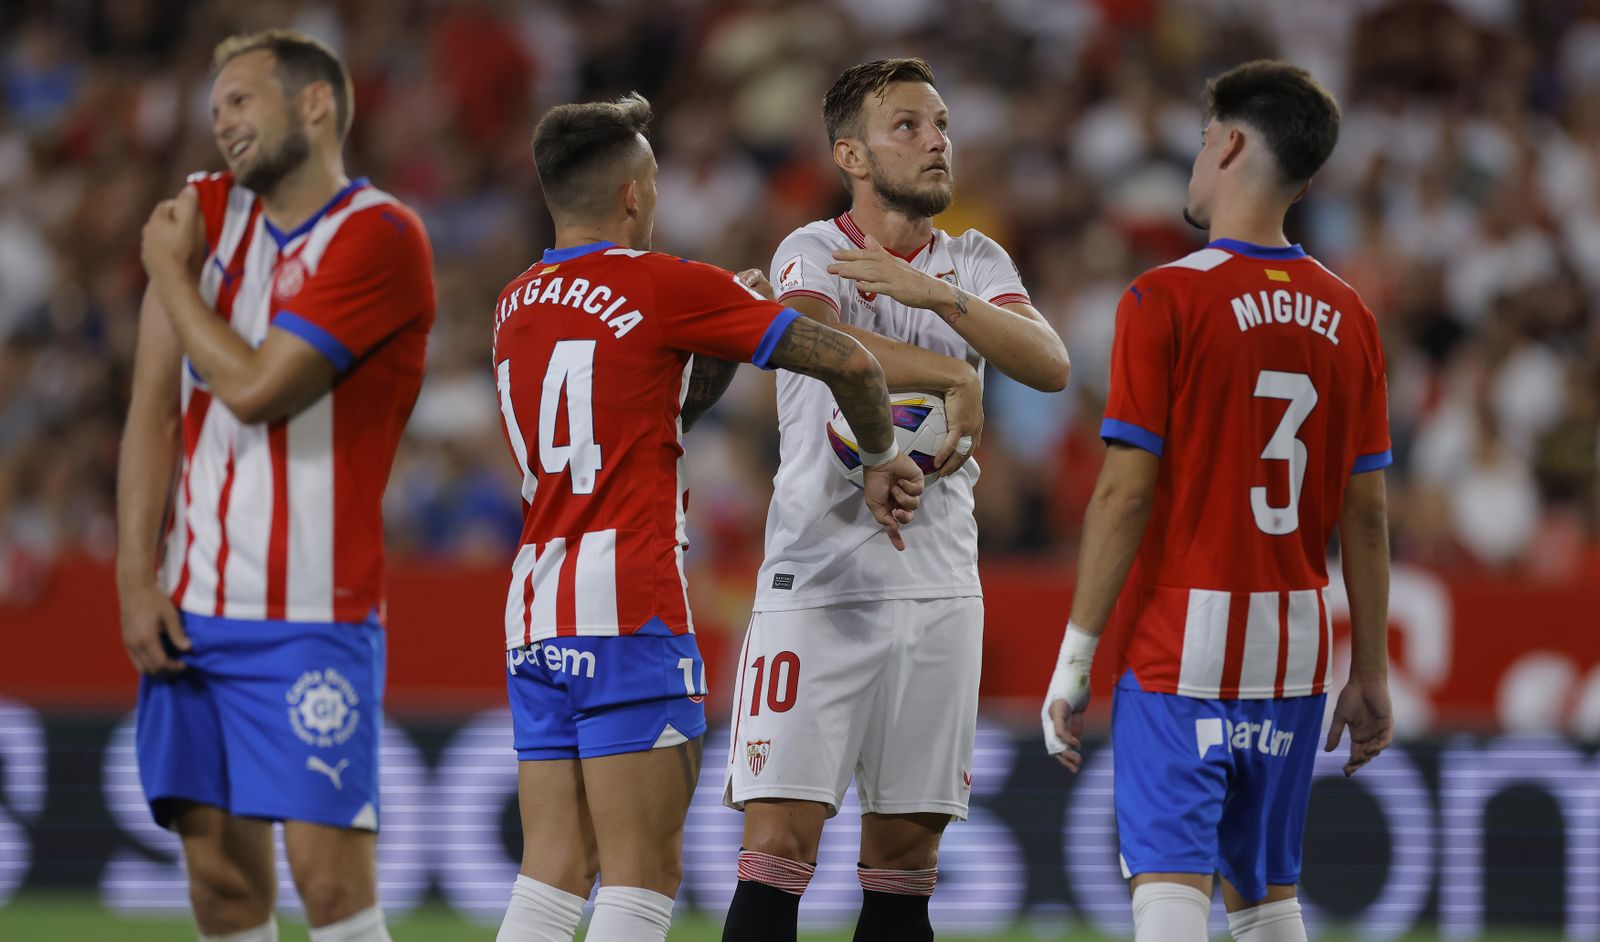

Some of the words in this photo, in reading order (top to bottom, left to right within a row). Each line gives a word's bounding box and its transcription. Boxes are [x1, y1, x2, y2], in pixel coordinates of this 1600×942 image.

[523, 276, 644, 340] GARCIA
[1231, 289, 1342, 346] MIGUEL
[497, 339, 603, 506] 14
[1250, 369, 1319, 535] 3
[509, 640, 596, 679] parem
[749, 650, 801, 717] 10
